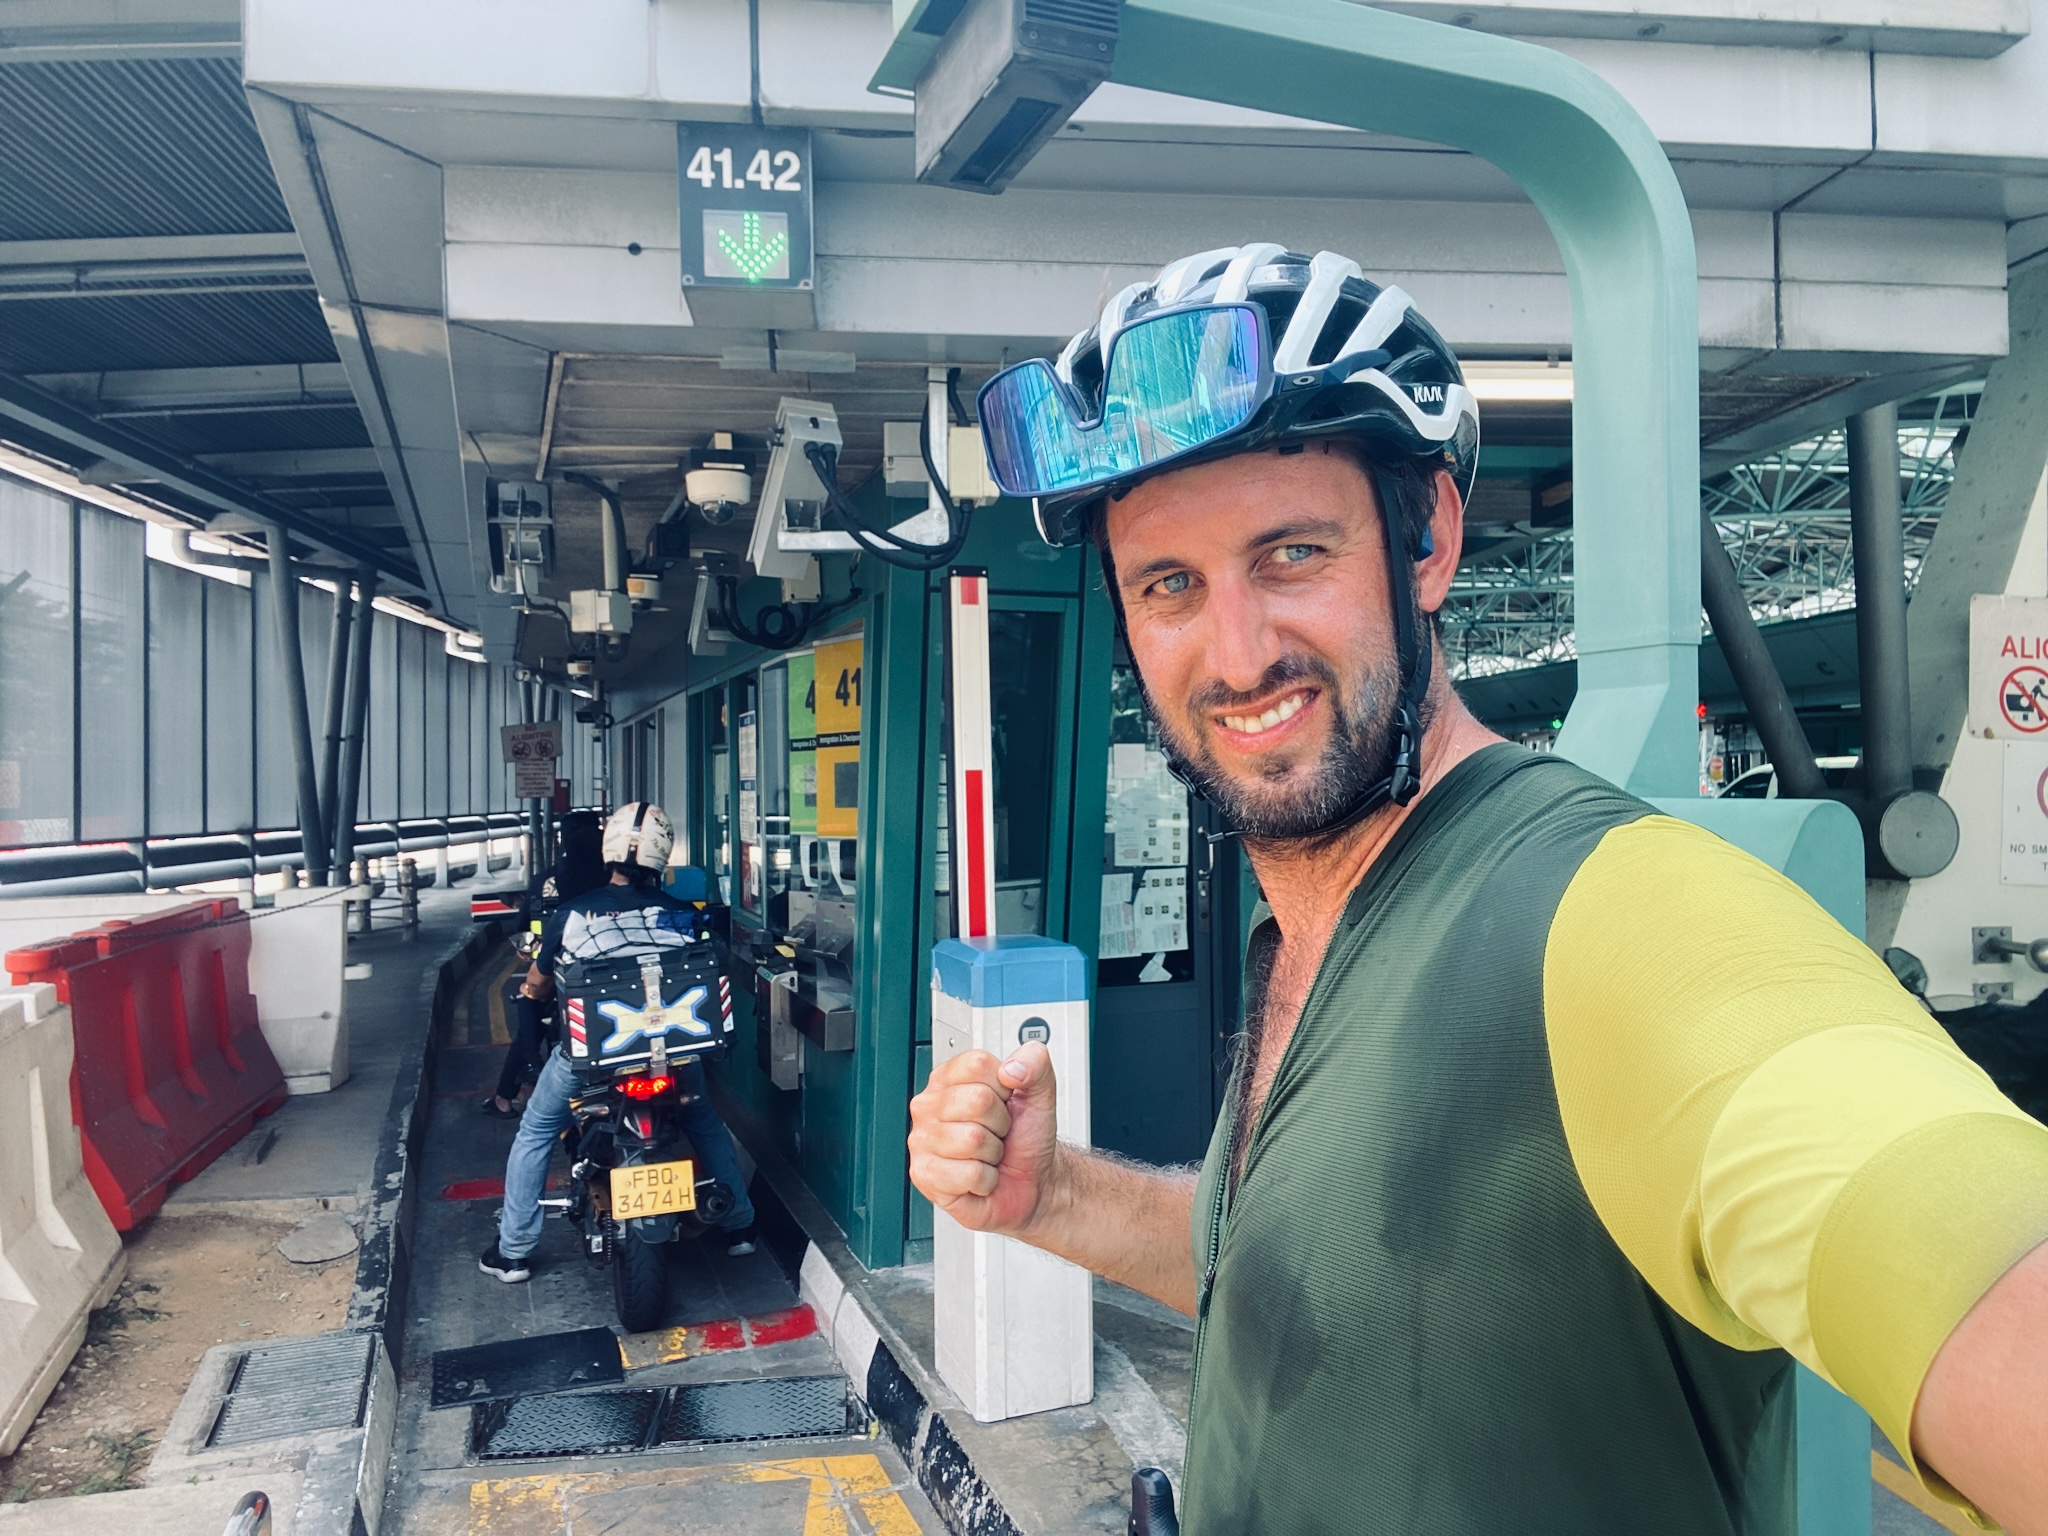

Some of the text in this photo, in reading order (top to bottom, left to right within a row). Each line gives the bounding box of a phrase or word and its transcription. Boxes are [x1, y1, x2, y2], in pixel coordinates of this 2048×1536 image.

[686, 146, 802, 191] 41.42
[835, 667, 861, 707] 41
[2010, 843, 2026, 854] NO
[632, 1167, 674, 1188] FBQ
